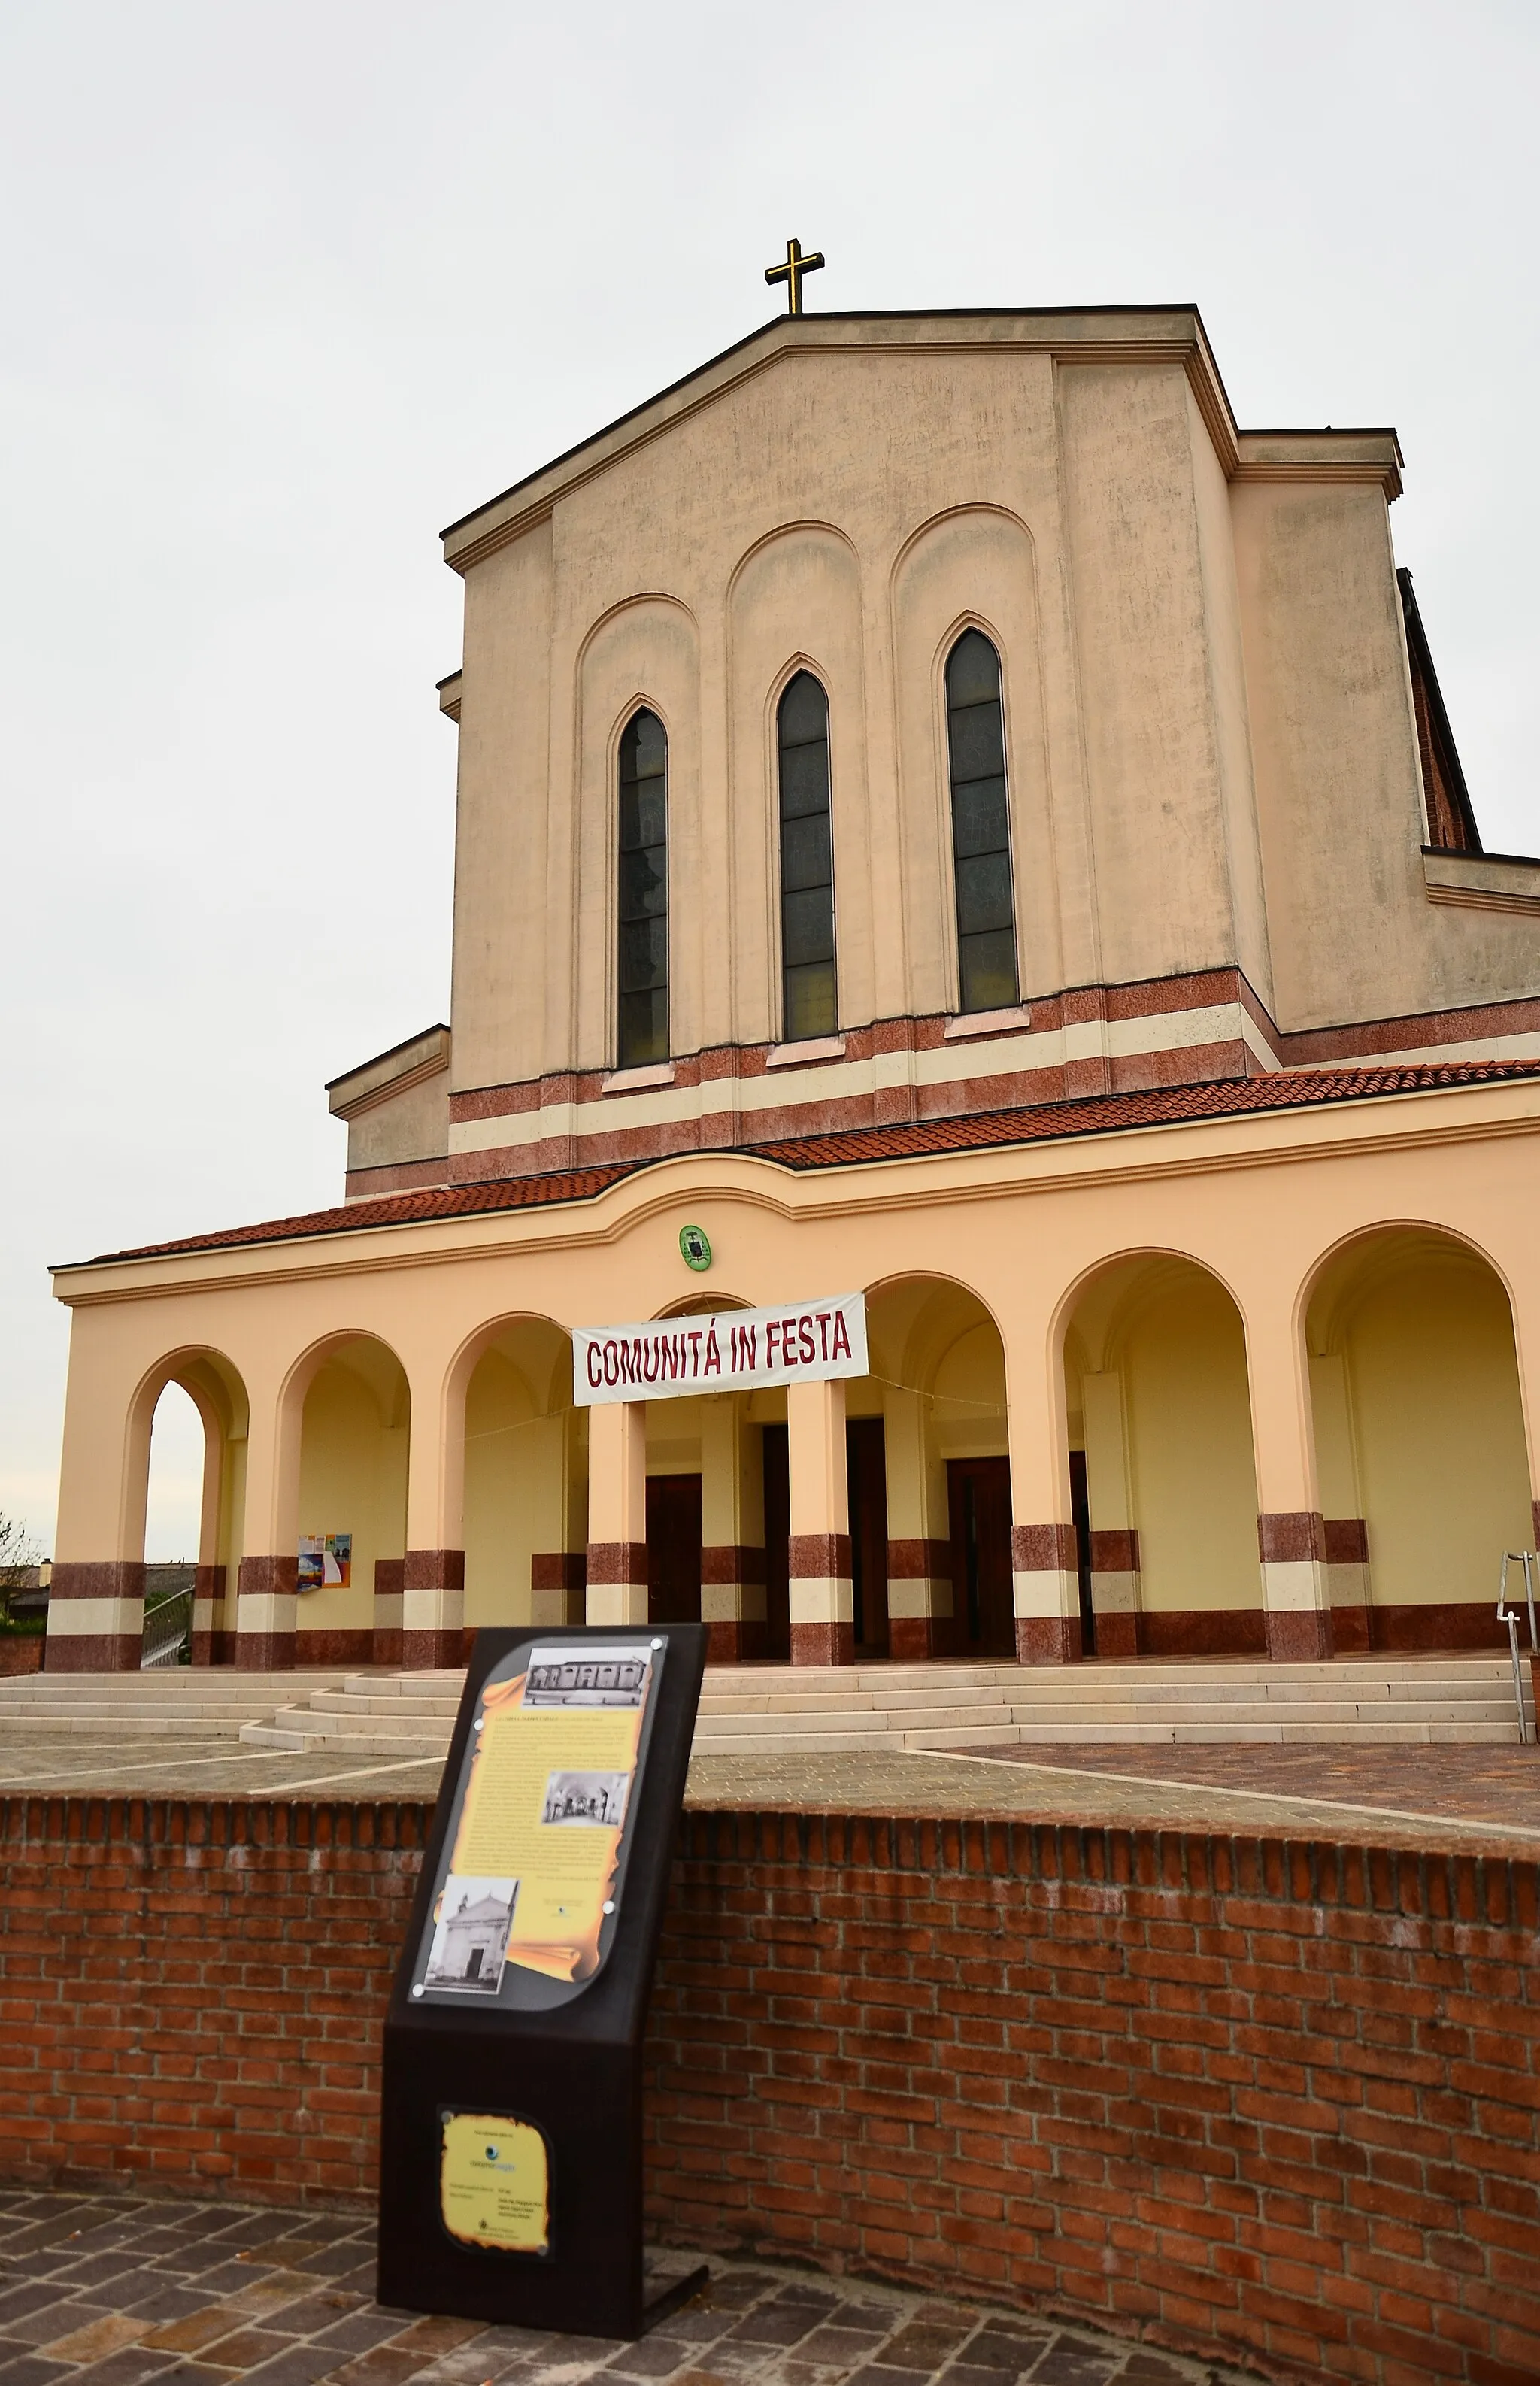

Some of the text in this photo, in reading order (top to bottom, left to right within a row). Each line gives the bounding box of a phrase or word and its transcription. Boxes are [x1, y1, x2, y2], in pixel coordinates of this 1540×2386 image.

[587, 1311, 852, 1388] COMUNITÁ IN FESTA
